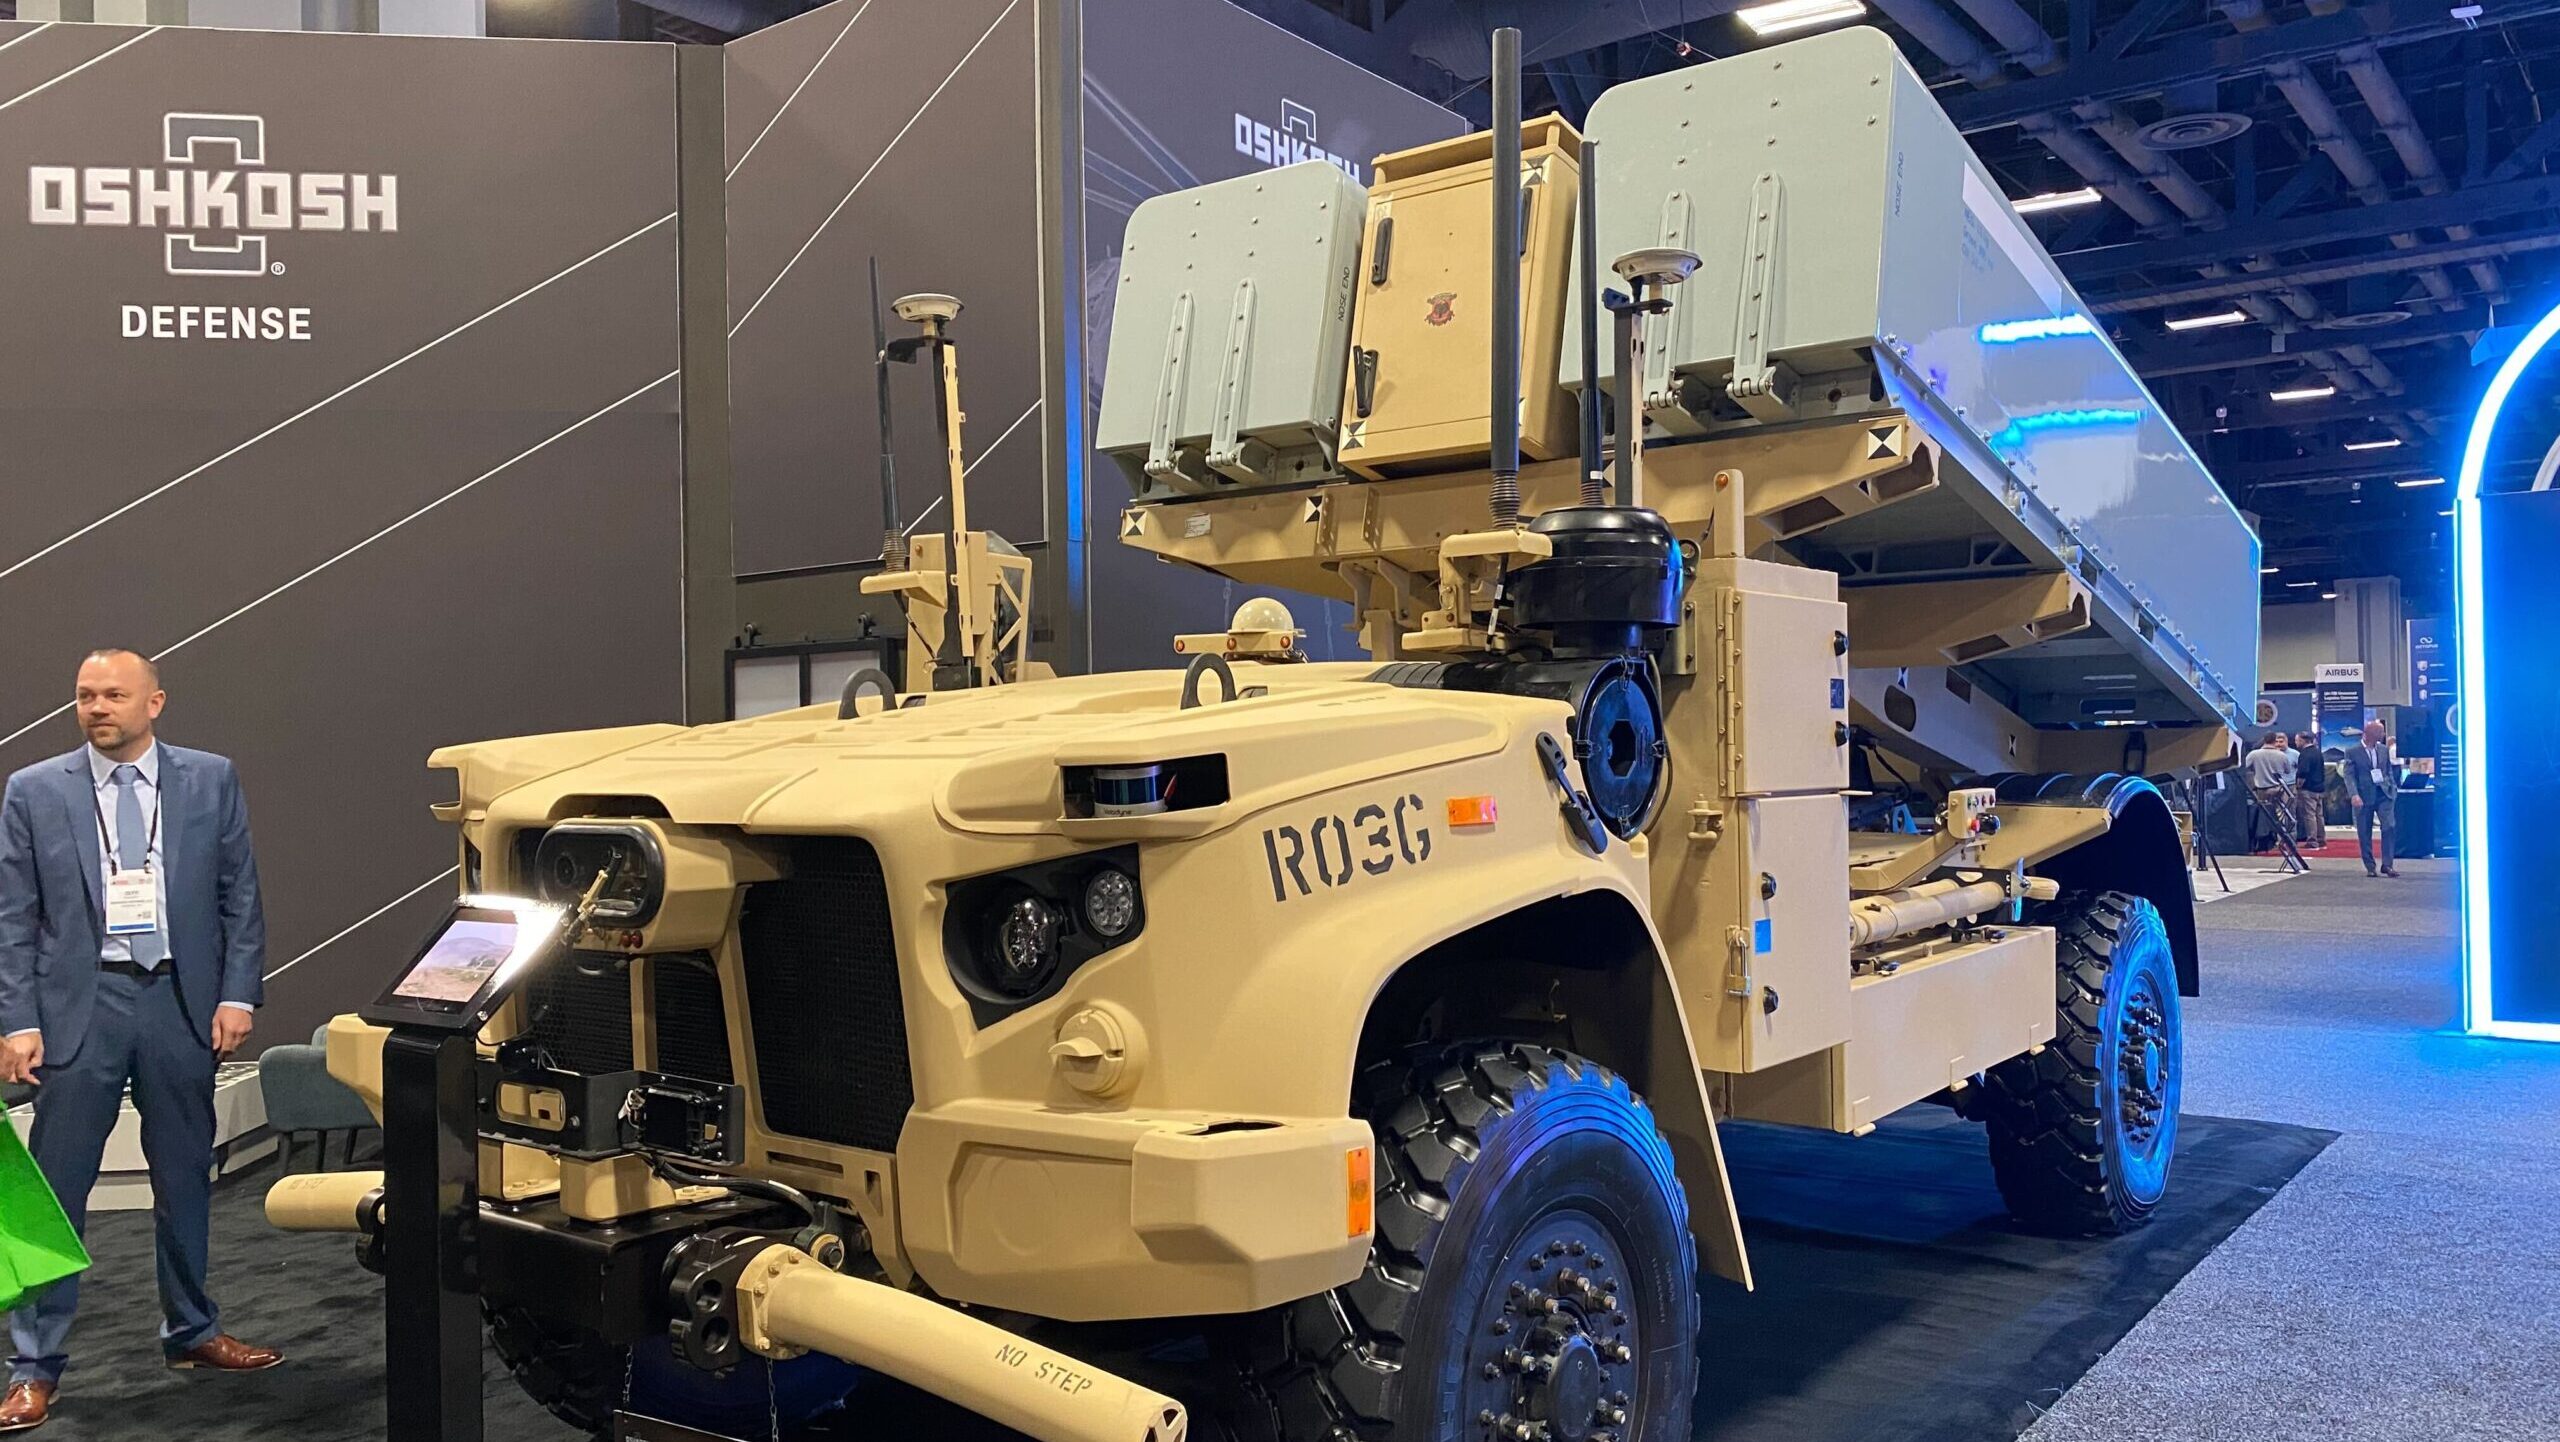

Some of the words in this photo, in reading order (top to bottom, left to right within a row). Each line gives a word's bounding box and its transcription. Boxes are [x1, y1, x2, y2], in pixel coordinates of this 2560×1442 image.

[29, 166, 399, 232] OSHKOSH
[1337, 291, 1347, 322] NOSE
[1342, 266, 1350, 290] END
[121, 304, 312, 340] DEFENSE
[2325, 668, 2359, 676] AIRBUS
[995, 1344, 1028, 1367] NO
[1035, 1361, 1093, 1395] STEP
